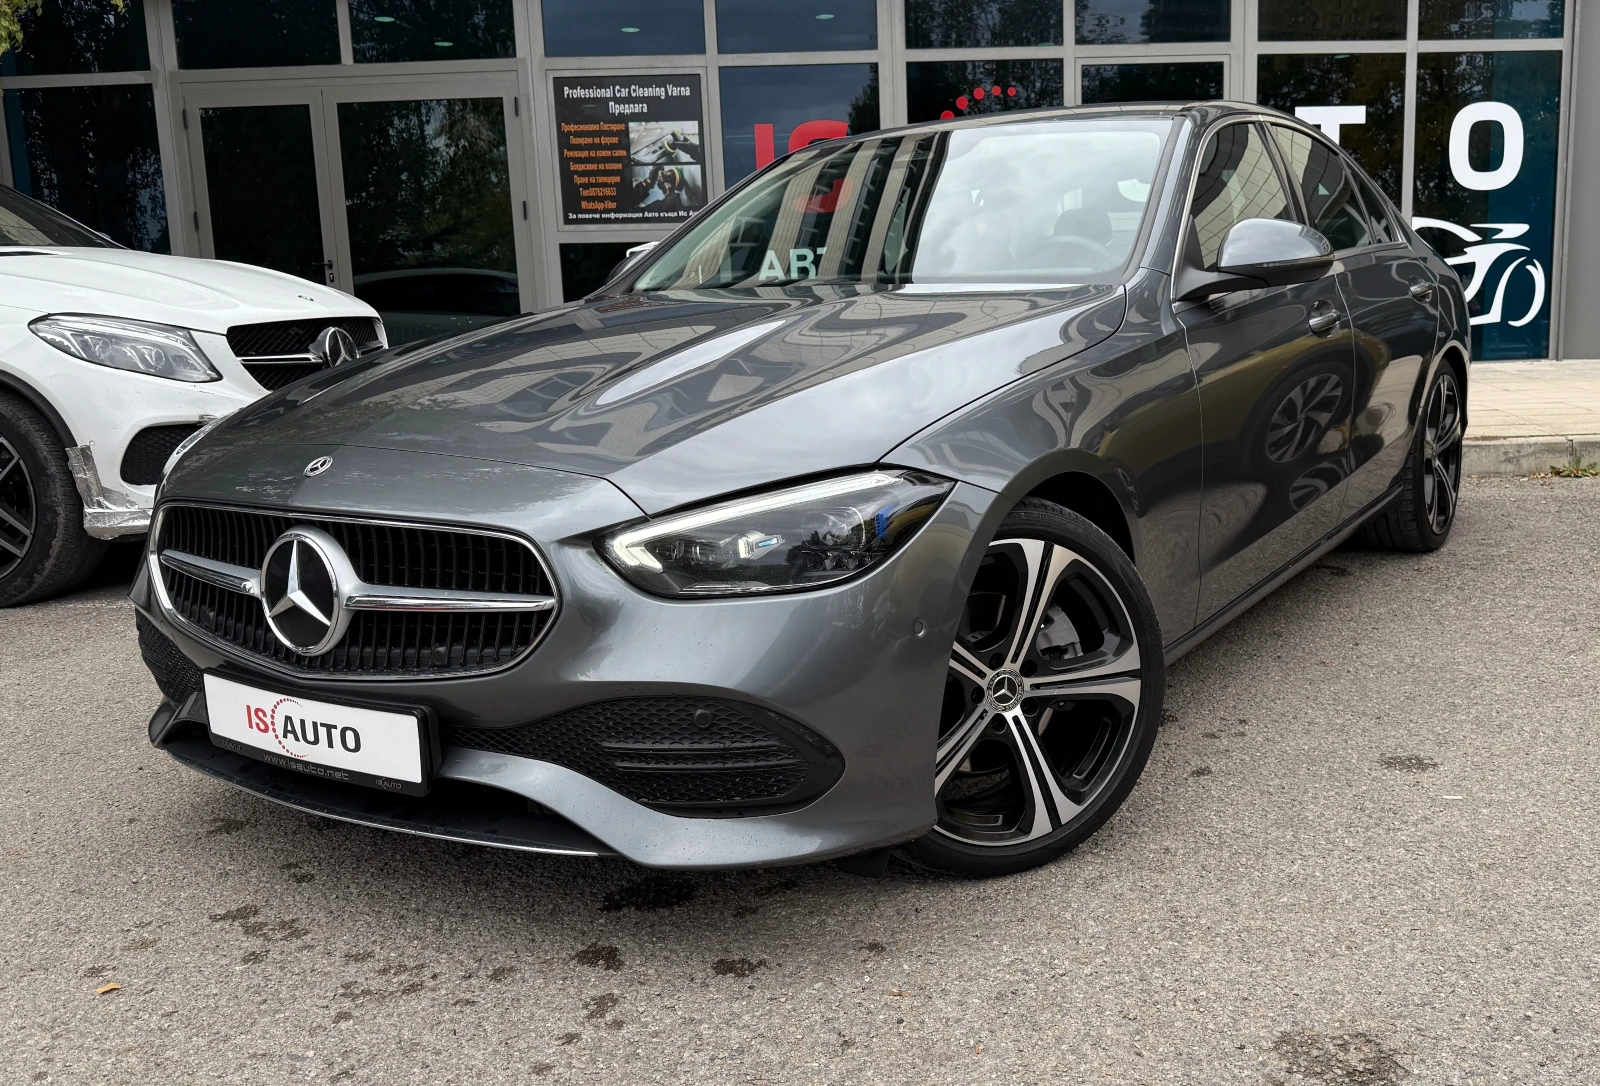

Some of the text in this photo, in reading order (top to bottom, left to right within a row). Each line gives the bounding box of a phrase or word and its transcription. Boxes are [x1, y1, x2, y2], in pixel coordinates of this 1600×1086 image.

[564, 84, 690, 99] Professional Car Cleaning Varna
[609, 102, 648, 115] Предлага
[570, 136, 593, 146] Полиране
[601, 136, 618, 145] фарове
[574, 175, 589, 185] Пране
[246, 704, 362, 753] IS AUTO
[263, 753, 350, 781] www.isauto.net
